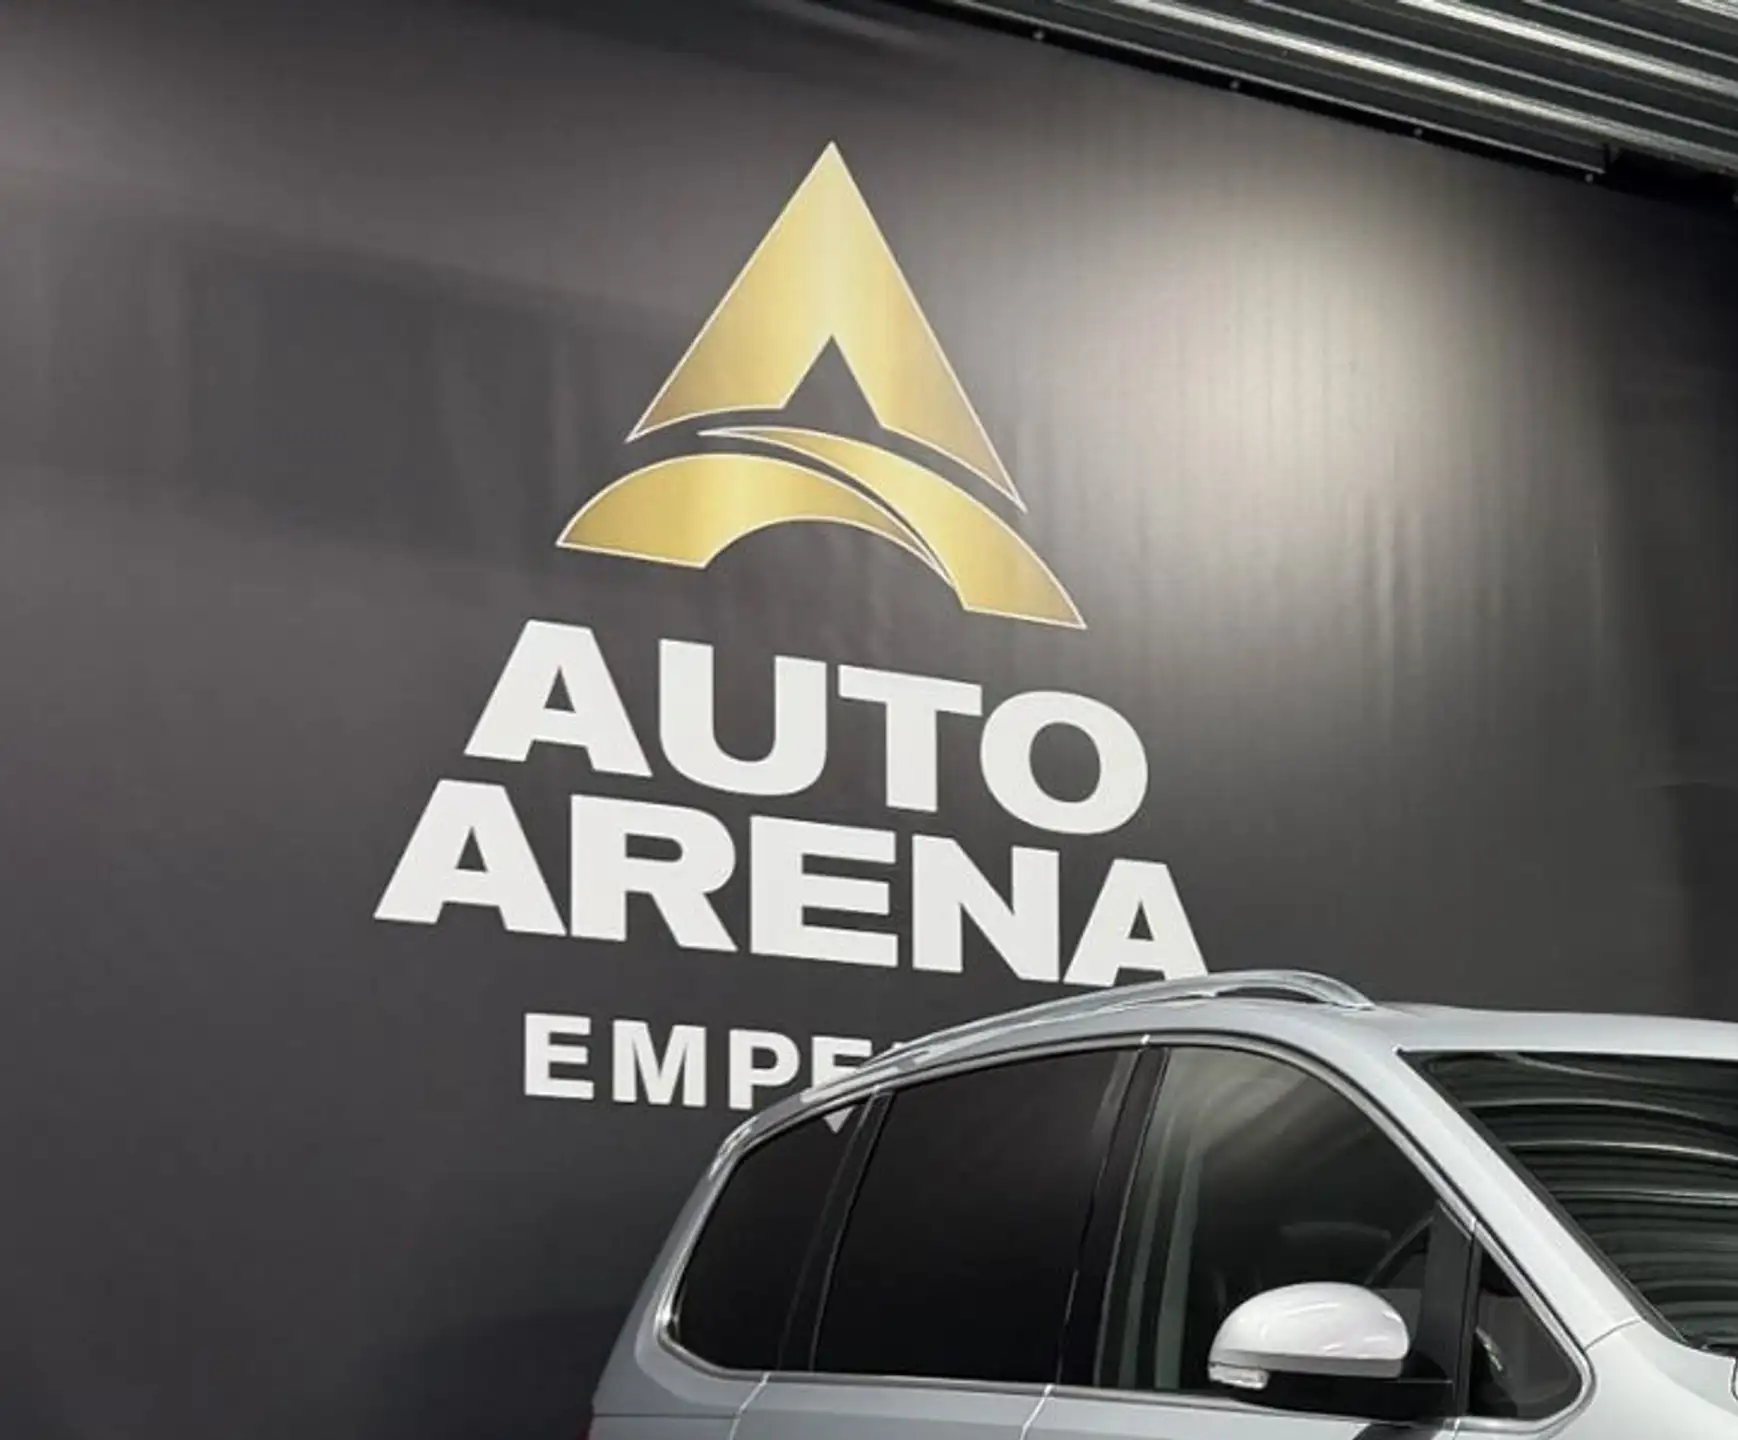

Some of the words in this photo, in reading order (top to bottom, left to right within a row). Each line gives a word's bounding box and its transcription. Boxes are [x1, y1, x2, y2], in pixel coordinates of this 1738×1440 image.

[463, 619, 1149, 835] AUTO
[373, 779, 1208, 987] ARENA
[523, 1012, 904, 1111] EMPE
